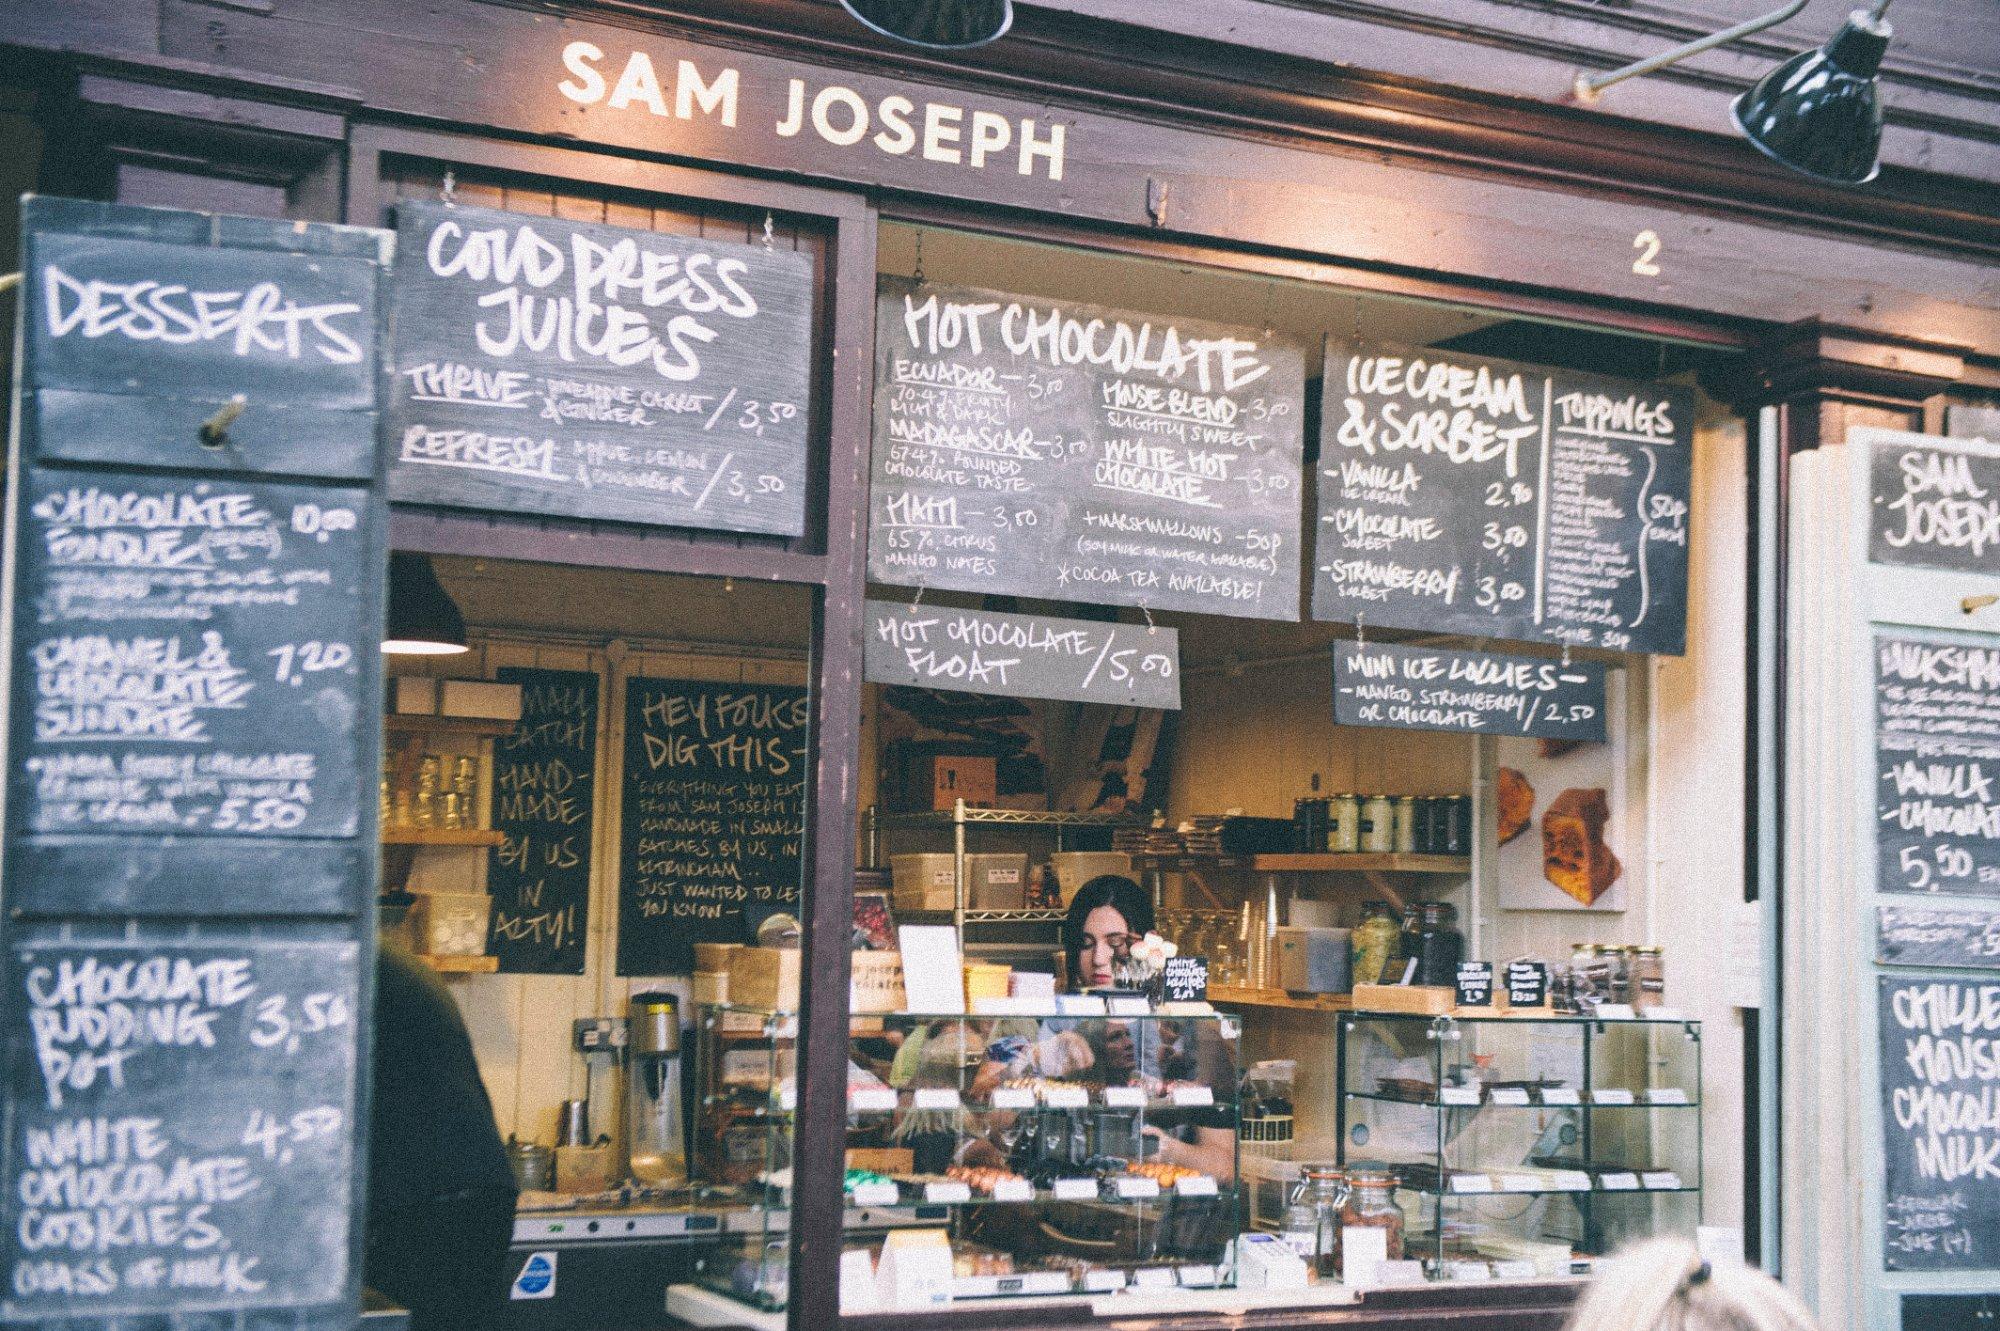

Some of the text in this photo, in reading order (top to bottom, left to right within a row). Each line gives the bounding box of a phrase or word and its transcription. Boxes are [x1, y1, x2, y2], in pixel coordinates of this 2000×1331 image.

[557, 41, 1067, 182] SAM JOSEPH
[427, 221, 759, 318] COLD PRESS
[1632, 230, 1661, 277] 2
[44, 265, 363, 364] DESSERTS
[475, 286, 720, 381] JUICES
[904, 294, 1271, 392] HOT CHOCOLATE
[402, 363, 531, 404] THRIVE
[894, 360, 1007, 396] ECUADOR
[1347, 354, 1534, 423] ICE CREAM
[738, 400, 797, 437] 3,50
[1168, 388, 1238, 425] BLEND
[889, 418, 1041, 461] MADAGASCAR
[1107, 411, 1264, 451] SLIGHTLY SWEET
[1337, 398, 1540, 478] & SORBET
[1102, 436, 1239, 482] WHITE HOT
[1340, 458, 1423, 492] VANILLA
[1900, 452, 1987, 498] SAM
[728, 470, 786, 503] 3,50
[1093, 461, 1212, 504] CHOCOLATE
[46, 489, 273, 528] CHOCOLATE
[1335, 506, 1445, 542] CHOCOLATE
[946, 556, 996, 576] NOTES
[1162, 551, 1209, 567] WATER
[1128, 570, 1160, 588] TEA
[1168, 573, 1263, 603] AVAILABLE!
[1331, 559, 1462, 605] STRAWBERRY
[878, 617, 1097, 655] HOT CHOCOLATE
[267, 640, 352, 686] 7.20
[905, 647, 1021, 685] FLOAT
[1347, 653, 1558, 691] MINI ICE LOLLIES
[642, 693, 708, 737] HEY
[1358, 704, 1486, 729] OR CHOCOLATE
[1544, 703, 1596, 724] 2,50
[643, 733, 701, 769] DIG
[211, 798, 308, 831] 5.50
[501, 793, 587, 824] MADE
[727, 799, 785, 815] JOSEPH
[545, 837, 579, 868] US
[719, 840, 741, 861] BY
[781, 844, 799, 857] IN
[682, 883, 748, 902] WANTED
[753, 887, 772, 901] TO
[26, 957, 258, 1008] CHOCOLATE
[250, 994, 350, 1053] 3,50
[26, 1116, 169, 1166] WHITE
[18, 1156, 262, 1206] CHOCOLATE
